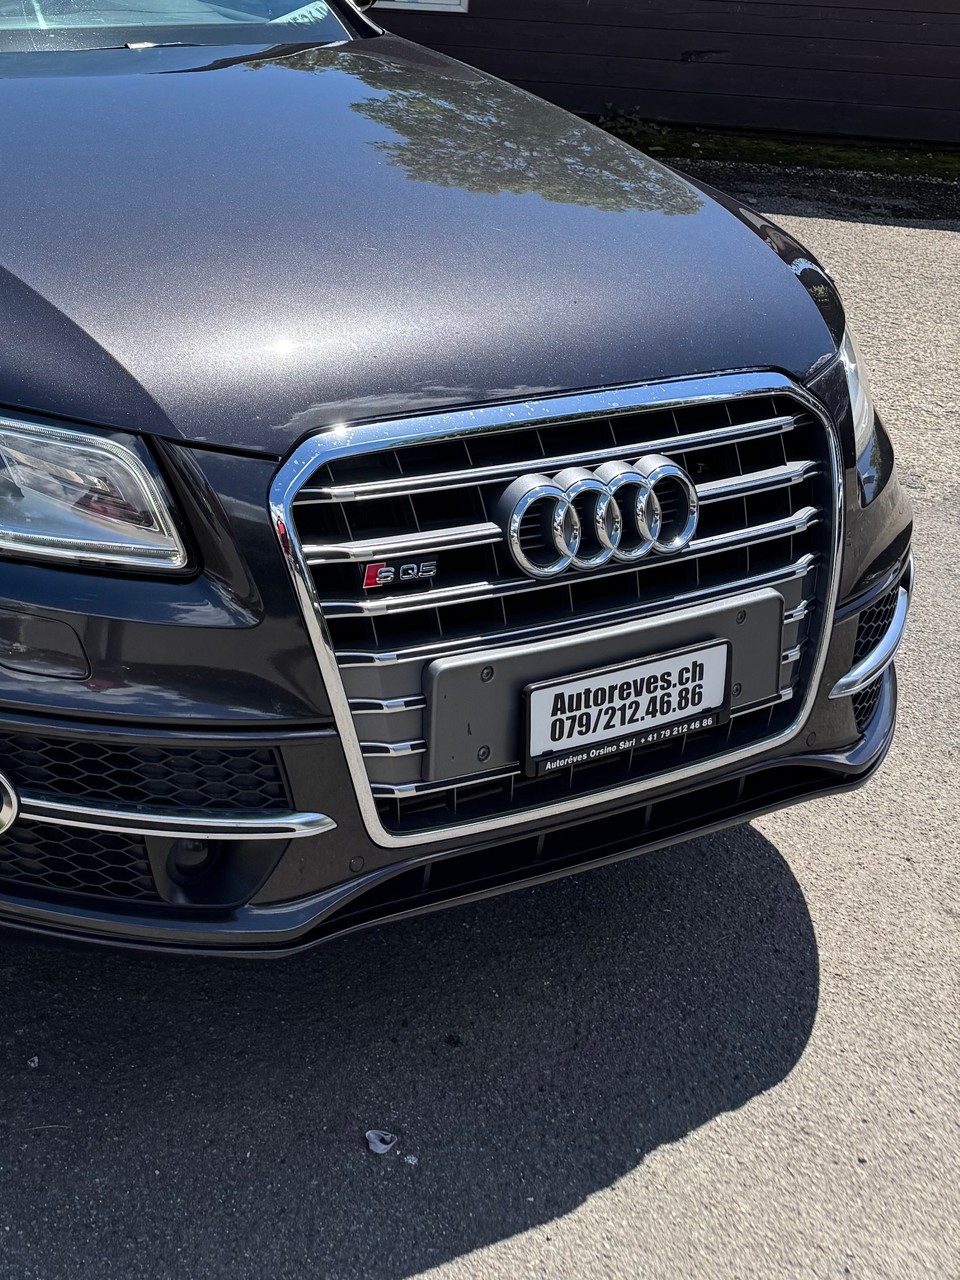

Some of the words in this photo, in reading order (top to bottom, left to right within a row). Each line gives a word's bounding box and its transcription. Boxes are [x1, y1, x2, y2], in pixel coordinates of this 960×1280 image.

[550, 660, 705, 718] Autoreves.ch
[550, 684, 704, 742] 079/212.46.86
[590, 745, 617, 758] Orsino
[647, 733, 658, 742] 41
[660, 729, 671, 738] 79
[673, 725, 688, 735] 212
[690, 720, 701, 730] 46
[702, 717, 713, 727] 86
